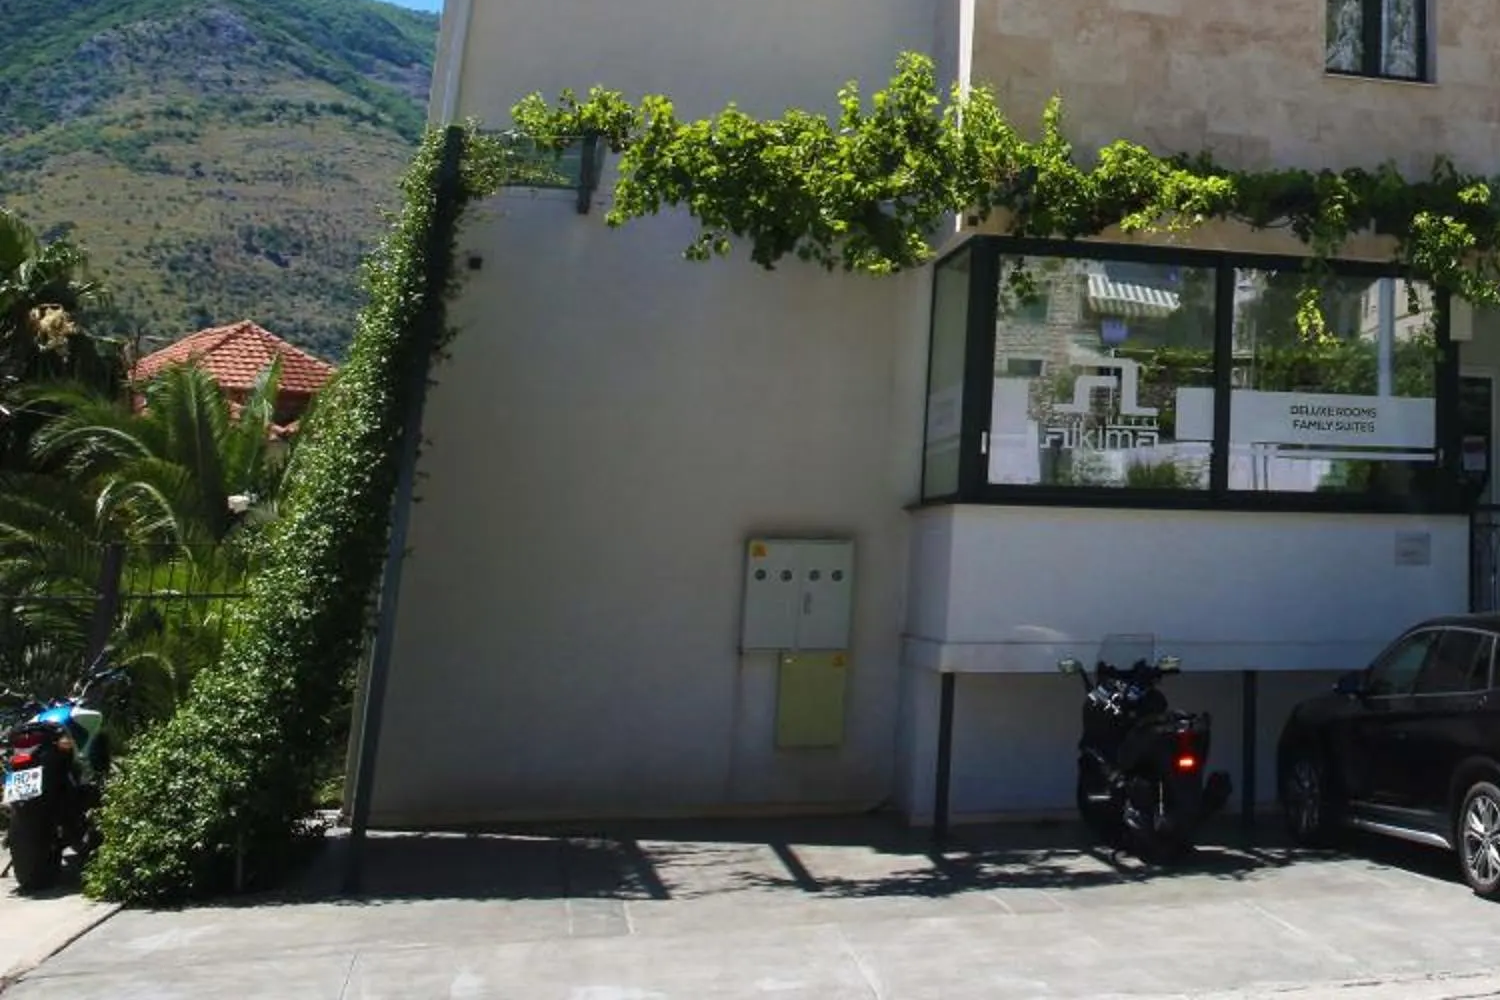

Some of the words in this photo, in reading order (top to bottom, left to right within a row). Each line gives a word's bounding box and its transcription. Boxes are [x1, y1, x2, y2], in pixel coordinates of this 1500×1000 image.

[1290, 405, 1335, 417] DELUXE
[1337, 407, 1377, 418] ROOMS
[1293, 420, 1333, 431] FAMILY
[1335, 421, 1375, 433] SUITES
